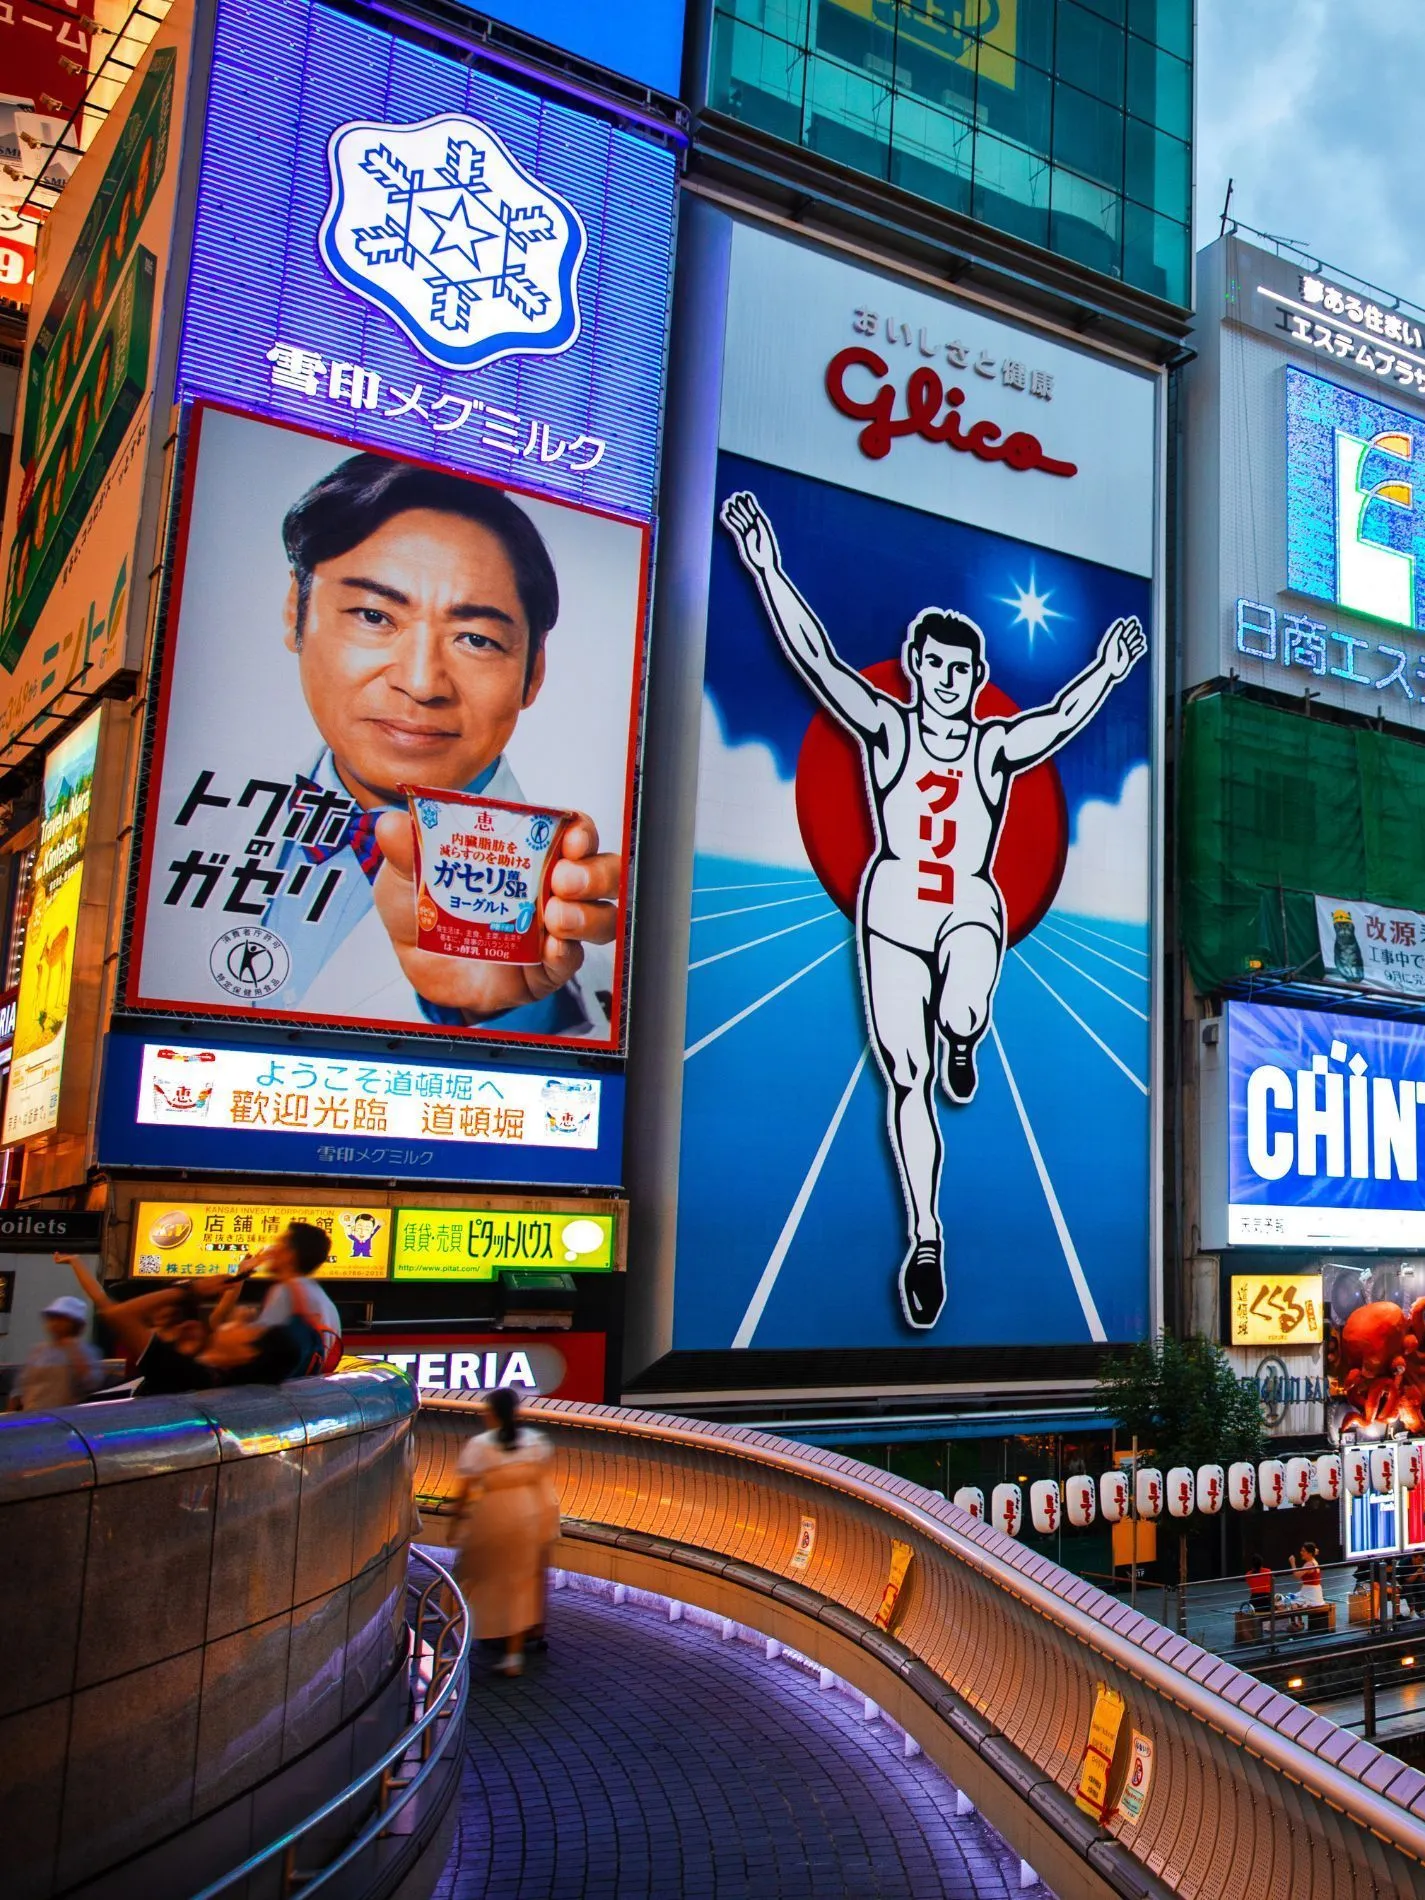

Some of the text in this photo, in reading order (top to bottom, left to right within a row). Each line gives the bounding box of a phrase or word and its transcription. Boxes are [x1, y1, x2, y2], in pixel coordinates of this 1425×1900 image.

[1303, 277, 1423, 349] 夢ある住まい
[853, 305, 1055, 400] おいしさと健康
[266, 340, 607, 472] 雪印メグミルク
[825, 346, 1078, 478] Glico
[174, 769, 356, 847] トクホ
[474, 811, 495, 833] 恵
[244, 838, 275, 858] の
[451, 832, 518, 855] 内臓脂肪を
[915, 768, 963, 905] グリコ
[440, 844, 531, 870] 減らすのを助ける
[164, 849, 342, 923] ガセリ
[433, 859, 507, 895] ガセリ
[450, 895, 509, 916] ヨーグルト
[484, 947, 511, 960] 100g
[256, 1060, 505, 1102] ようこそ道頓堀へ
[230, 1089, 526, 1141] 歡迎光臨 道頓堀
[315, 1144, 435, 1167] 雪印メグミルク
[0, 1215, 67, 1235] oilets
[205, 1206, 336, 1217] KANSAI INVEST CORPORATION
[403, 1222, 464, 1253] 賃貸・売買
[467, 1217, 554, 1259] ピタットハウス
[165, 1262, 220, 1275] 株式会社
[398, 1263, 480, 1273] http://www.pitat.com/
[1249, 1284, 1305, 1334] くくる
